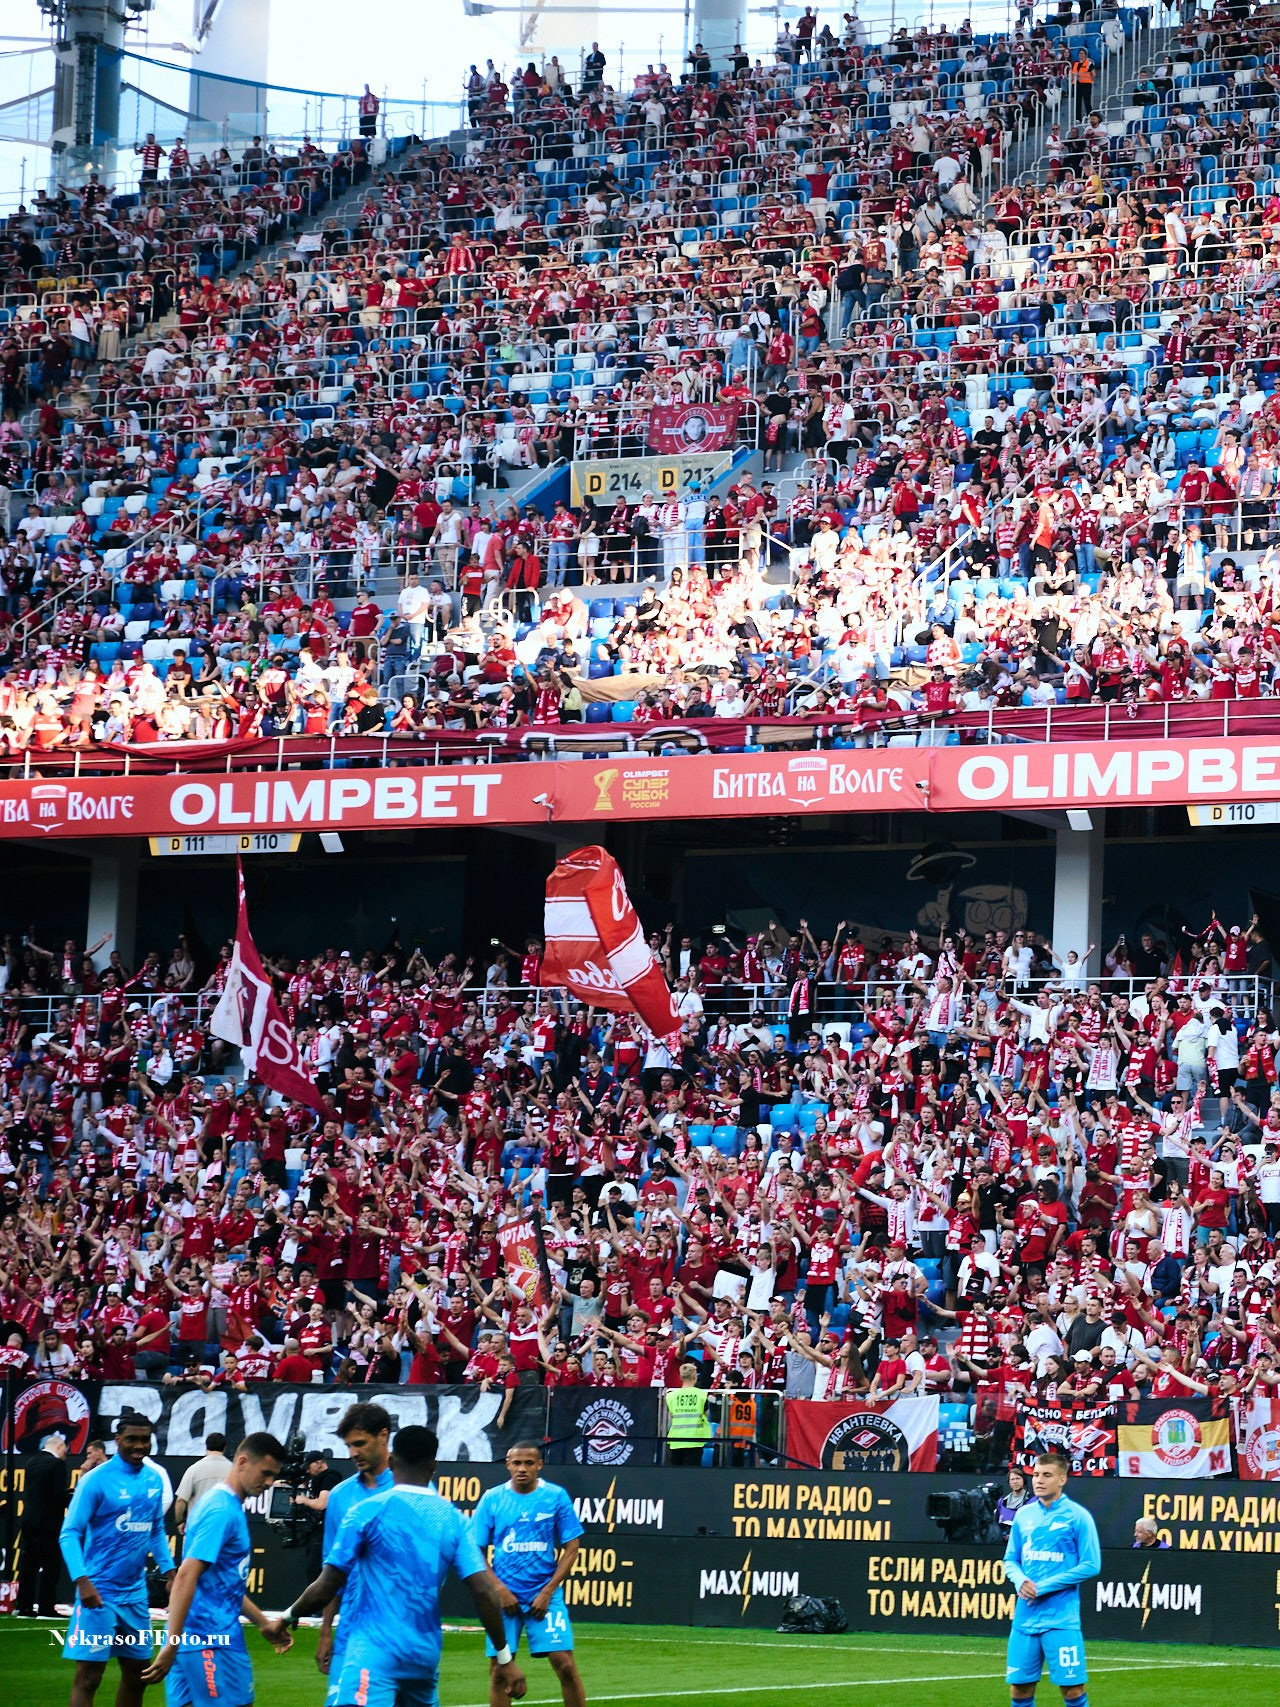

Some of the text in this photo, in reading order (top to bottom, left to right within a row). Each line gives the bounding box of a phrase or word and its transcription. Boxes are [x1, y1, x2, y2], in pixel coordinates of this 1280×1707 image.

[590, 471, 642, 492] D 214
[662, 470, 674, 487] D
[623, 770, 670, 778] OLIMPBET
[623, 778, 670, 790] СУПЕР
[168, 773, 502, 826] OLIMPBET
[622, 790, 669, 801] КУБОК
[630, 801, 661, 809] РОССИИ
[1213, 804, 1255, 821] D 110
[172, 836, 205, 851] D 111
[241, 834, 278, 850] D 110
[735, 1405, 751, 1421] 69
[828, 1415, 903, 1446] ИВАНТЕЕВКА
[1016, 1452, 1108, 1472] КИВСК
[438, 1476, 481, 1502] ДИО
[734, 1484, 785, 1509] ЕСЛИ
[796, 1485, 872, 1513] РАДИО
[1143, 1493, 1204, 1521] ЕСЛИ
[732, 1516, 760, 1537] ТО
[1158, 1529, 1172, 1547] О
[554, 1548, 616, 1576] ДИО
[868, 1556, 1005, 1589] ЕСЛИ РАДИО
[559, 1580, 632, 1607] IMUM!
[867, 1589, 895, 1617] ТО
[545, 1611, 566, 1632] 14
[1059, 1646, 1080, 1667] 61
